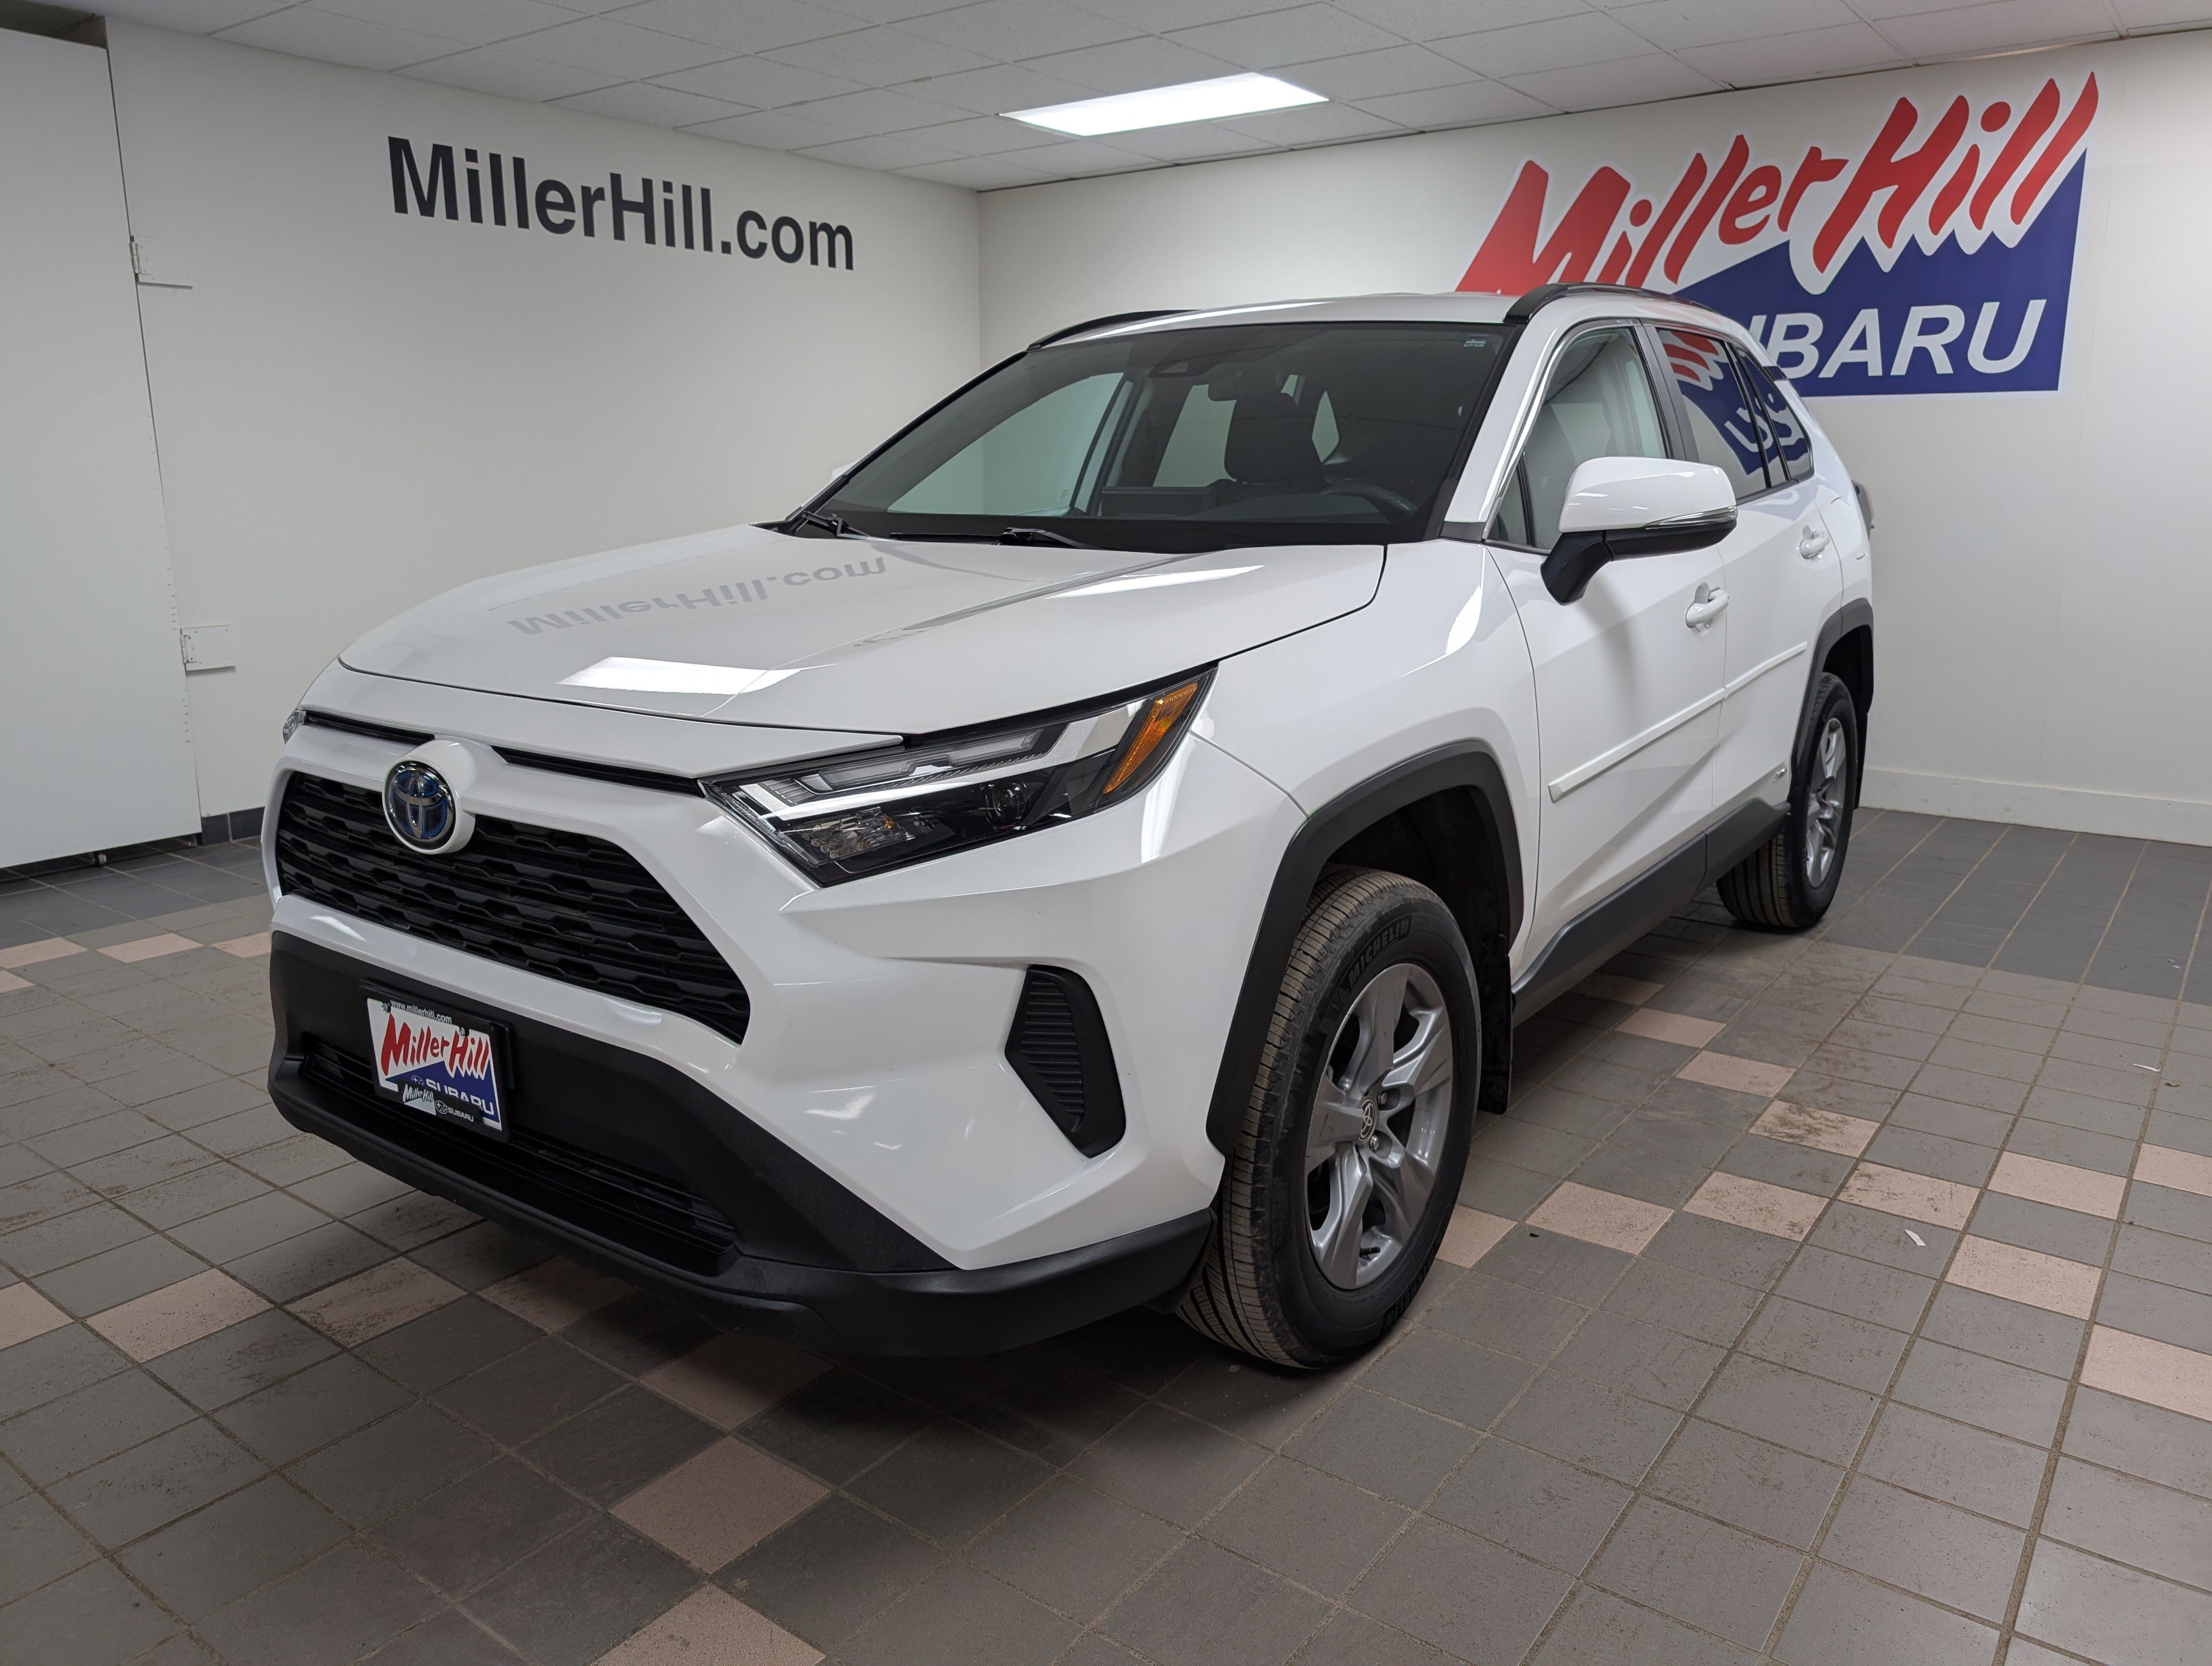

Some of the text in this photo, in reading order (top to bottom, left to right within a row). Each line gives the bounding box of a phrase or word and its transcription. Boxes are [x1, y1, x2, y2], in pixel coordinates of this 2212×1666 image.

[388, 136, 853, 270] MillerHill.com
[1749, 299, 2047, 379] BARU
[1349, 919, 1410, 989] MICHELIN
[390, 1000, 452, 1024] www.millerhill.com
[447, 1107, 474, 1122] SUBARU
